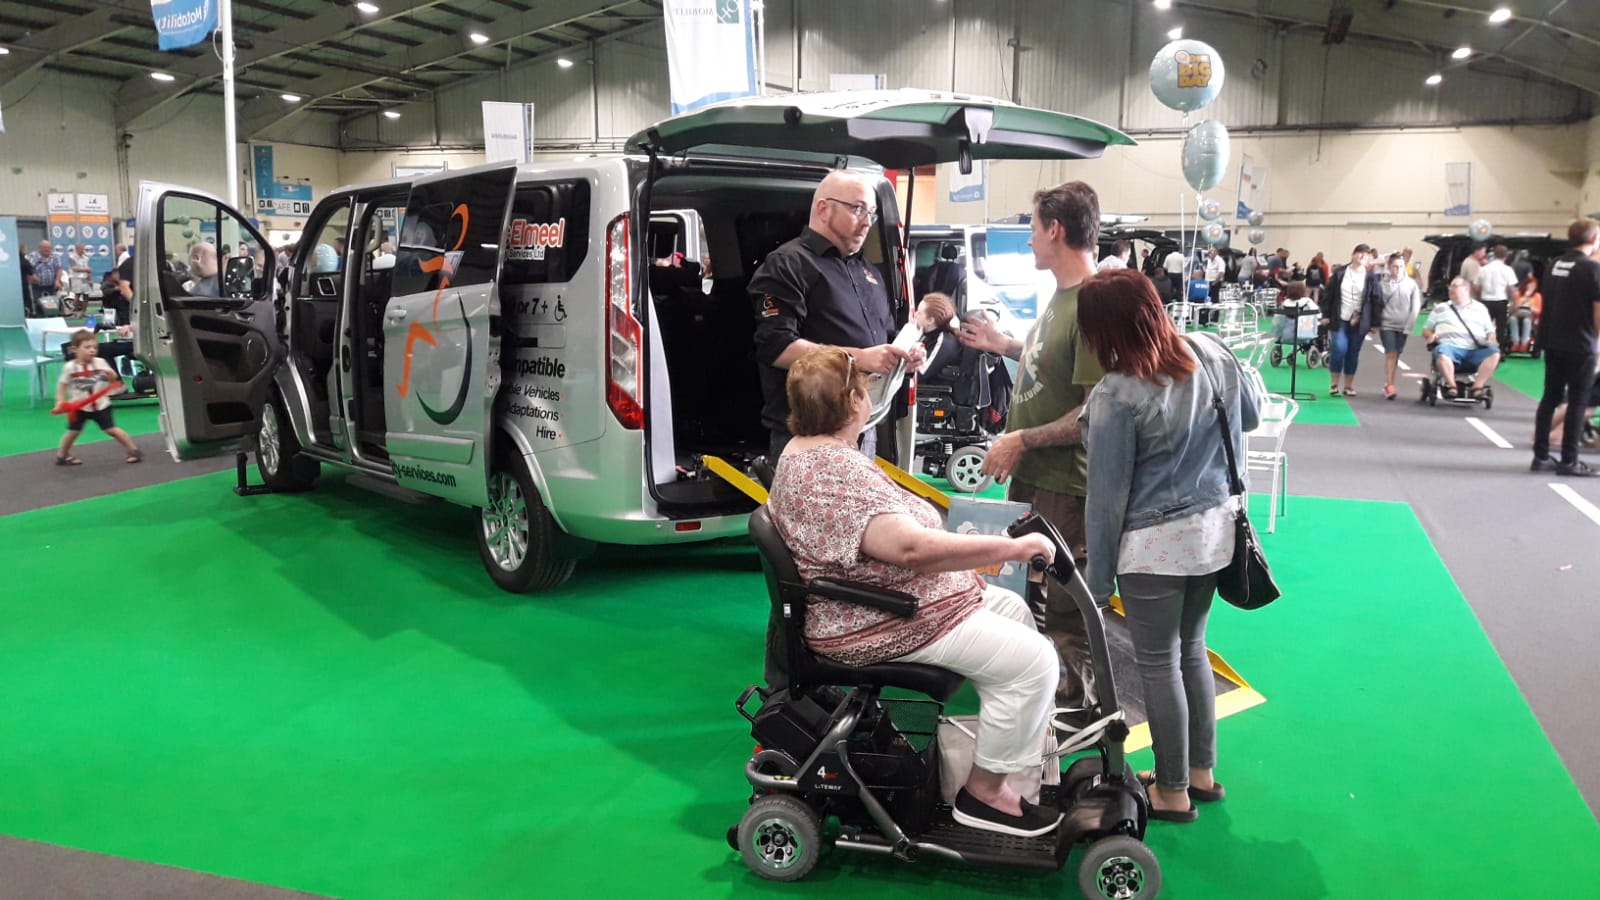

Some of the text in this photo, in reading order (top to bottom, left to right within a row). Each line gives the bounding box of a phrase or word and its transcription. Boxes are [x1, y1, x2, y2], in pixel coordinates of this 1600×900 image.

[511, 218, 565, 248] Elmeel
[523, 384, 560, 402] Vehicles
[535, 425, 557, 440] Hire
